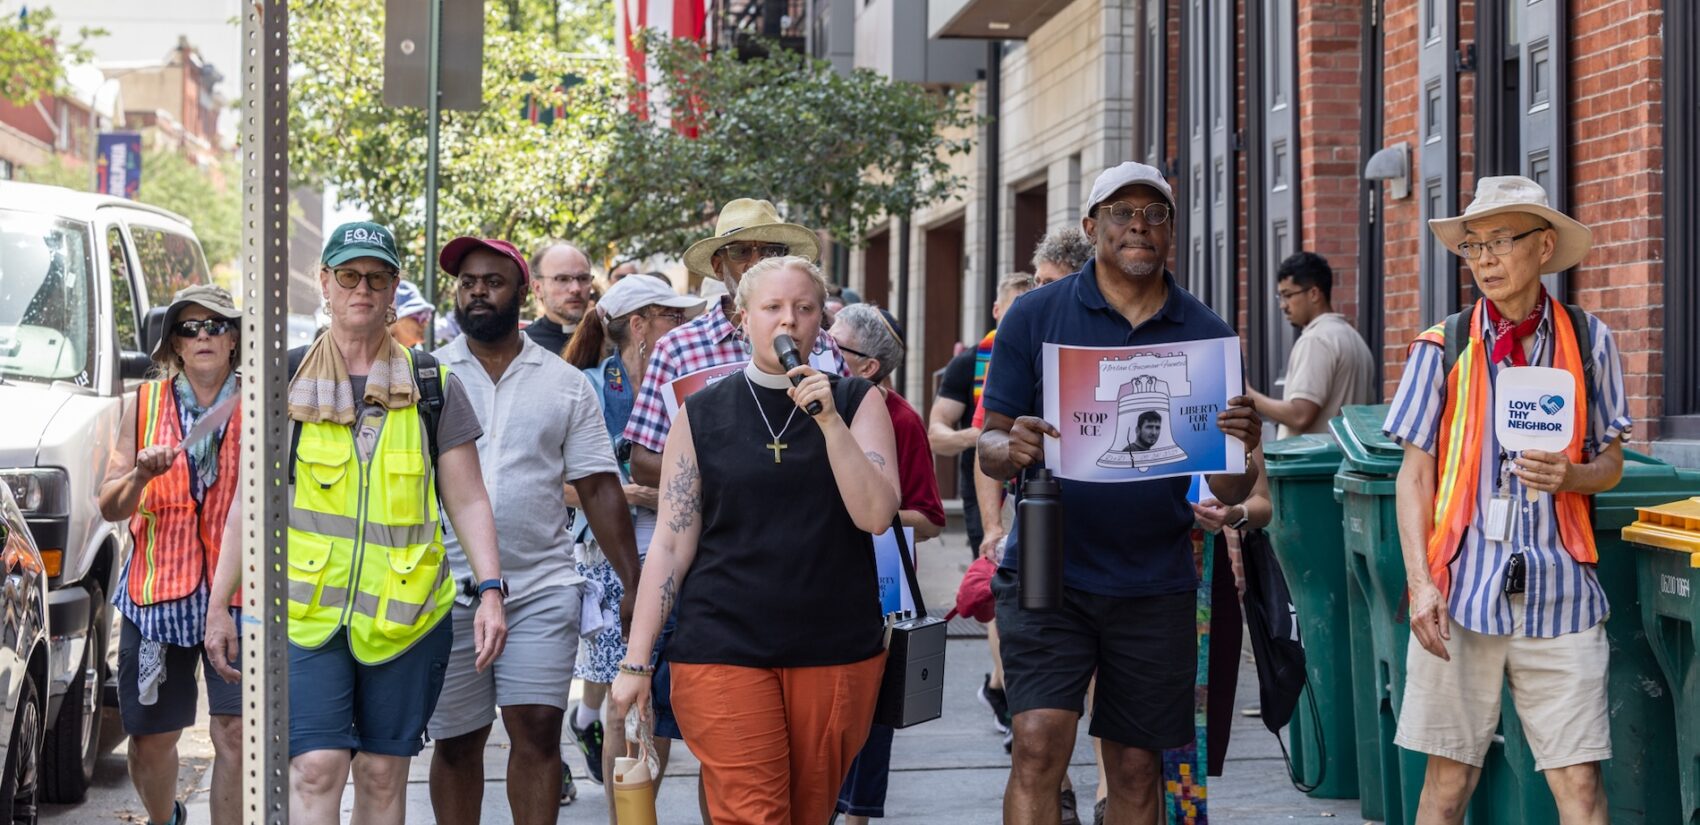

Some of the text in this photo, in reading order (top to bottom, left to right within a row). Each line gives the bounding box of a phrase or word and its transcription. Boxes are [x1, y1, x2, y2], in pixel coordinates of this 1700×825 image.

[1180, 404, 1219, 415] LIBERTY
[1509, 400, 1537, 411] LOVE
[1073, 411, 1108, 424] STOP
[1188, 414, 1208, 423] FOR
[1509, 410, 1529, 420] THY
[1080, 425, 1102, 437] ICE
[1191, 422, 1208, 432] ALL
[1508, 419, 1562, 432] NEIGHBOR
